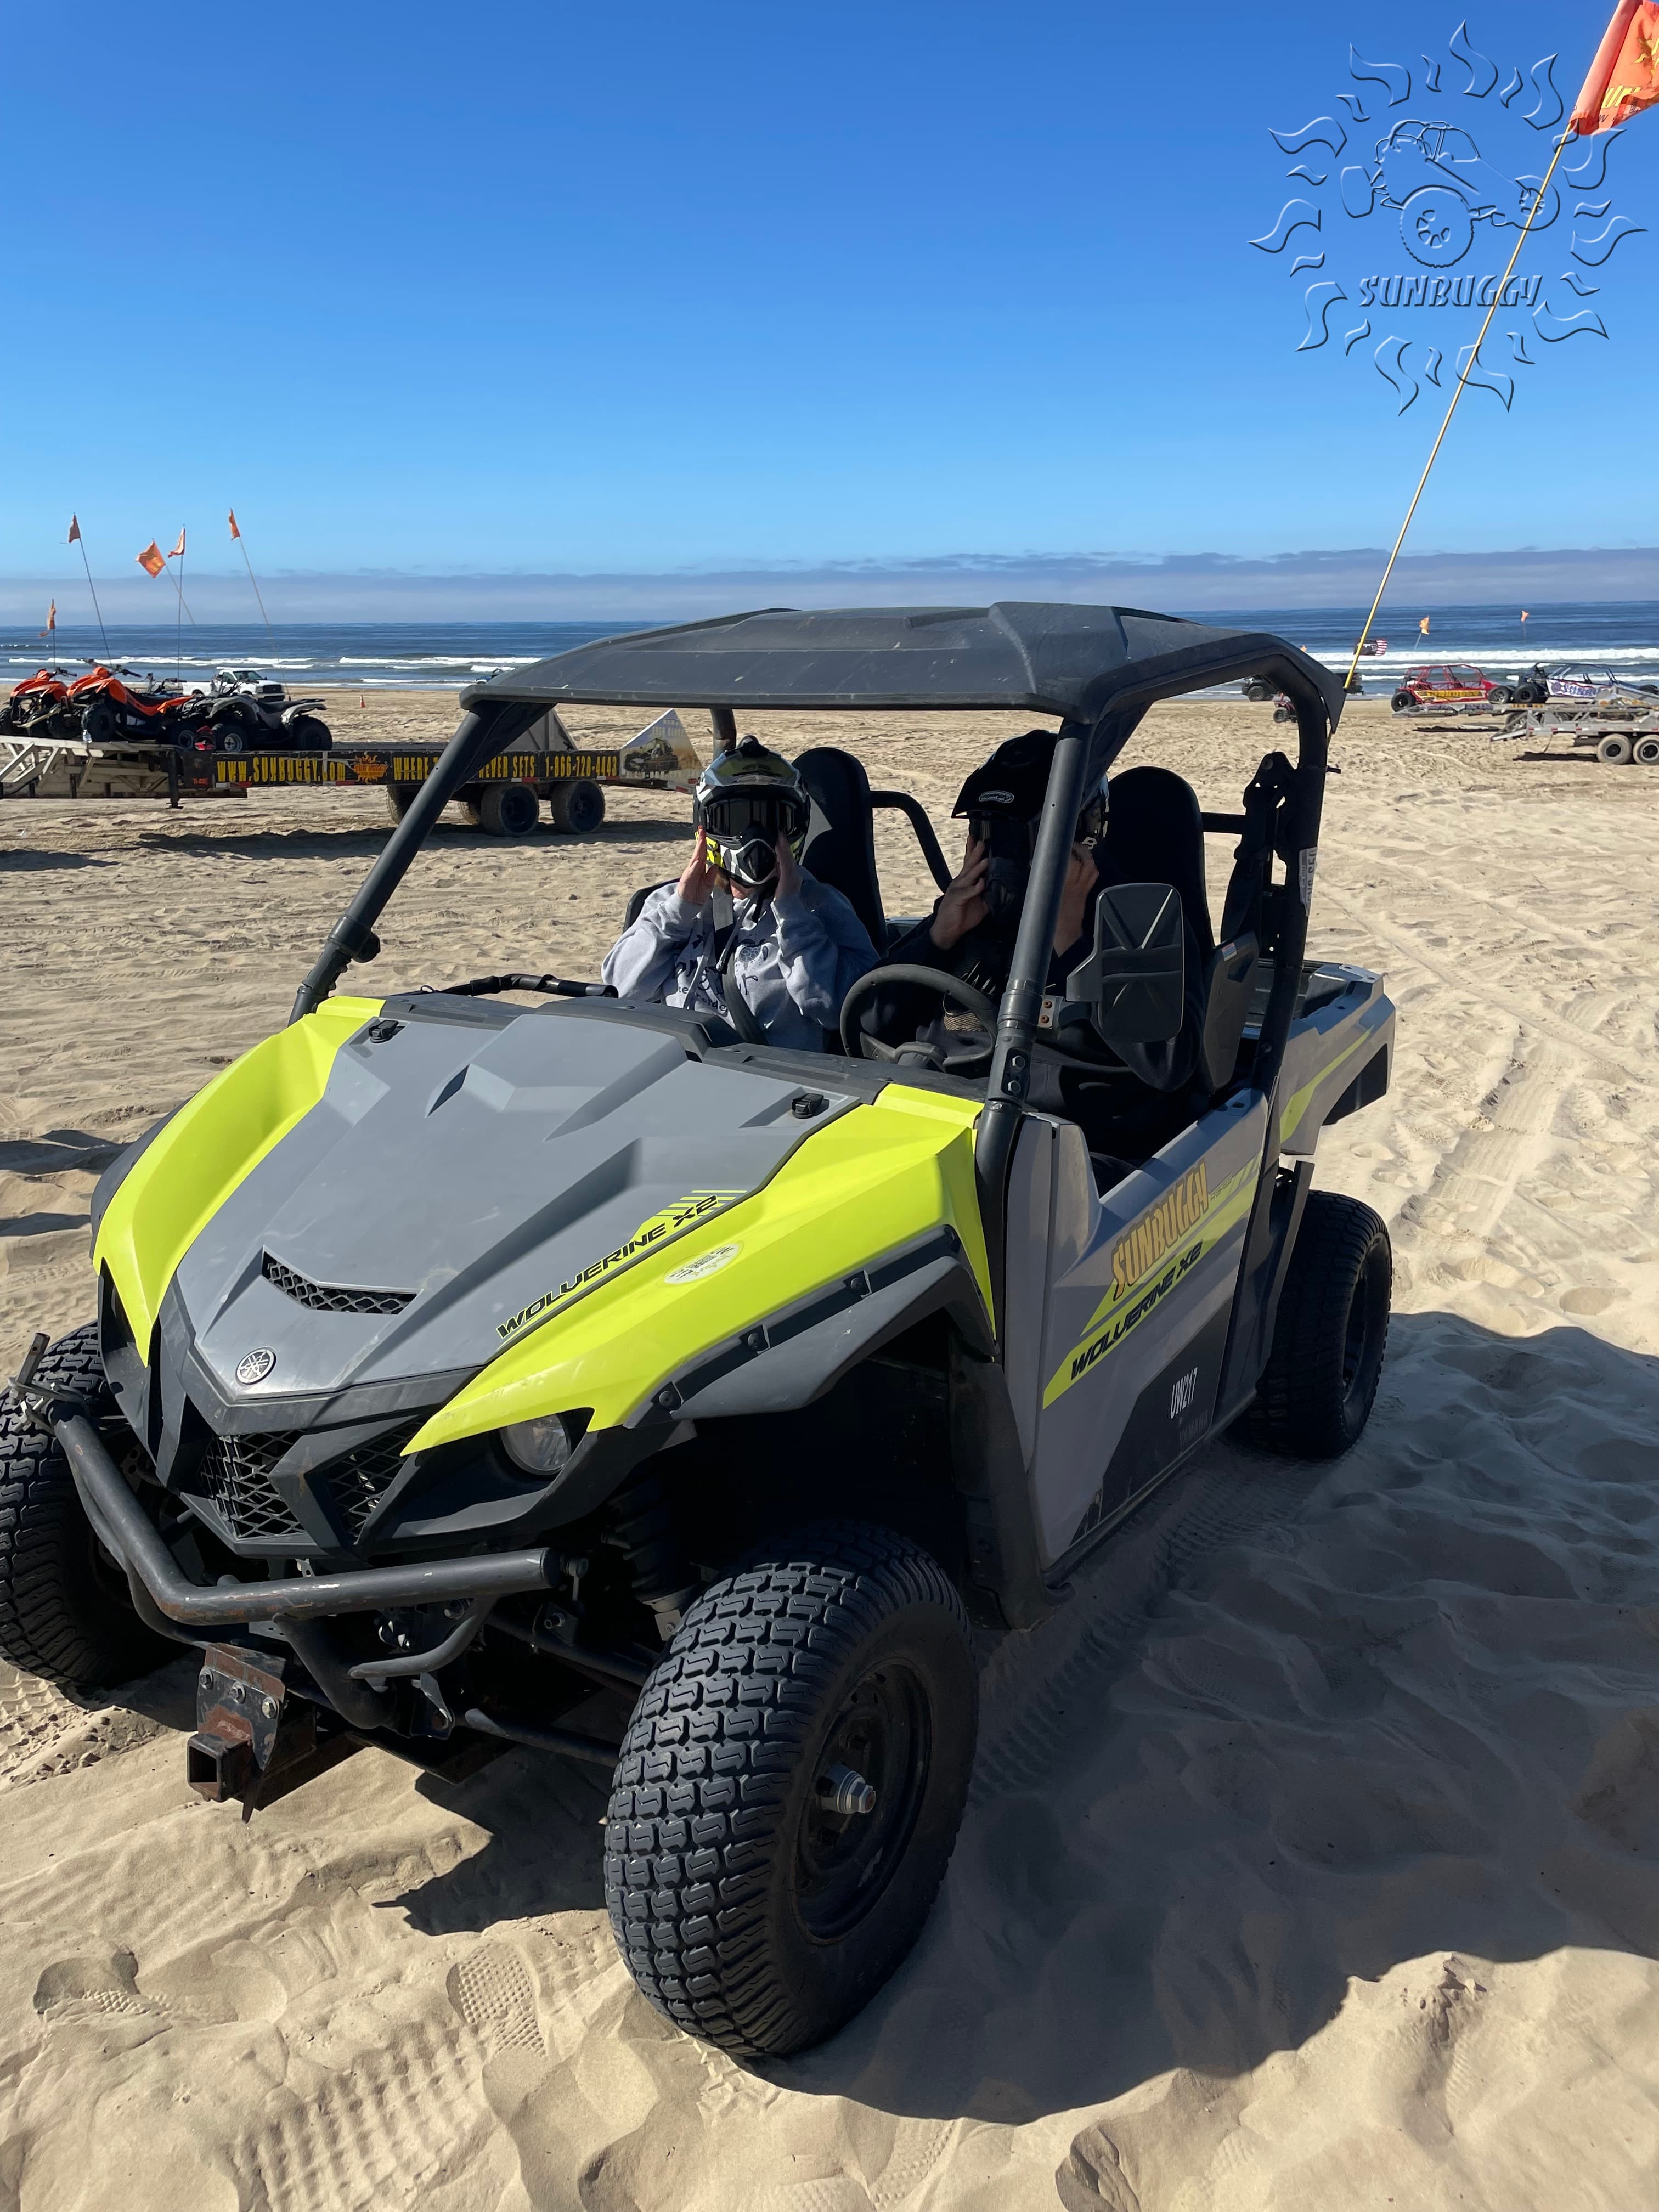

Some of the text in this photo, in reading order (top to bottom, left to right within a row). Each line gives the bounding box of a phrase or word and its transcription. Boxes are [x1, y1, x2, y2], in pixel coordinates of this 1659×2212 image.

[393, 756, 430, 781] WHERE
[513, 755, 535, 778] SETS
[545, 755, 617, 777] 1-866-728-4443
[496, 1222, 667, 1339] WOLVERINE
[673, 1194, 718, 1228] X2
[1111, 1159, 1211, 1302] SUNBUGGY
[1070, 1240, 1203, 1382] WOLVERINE X2
[1170, 1365, 1198, 1420] UW217
